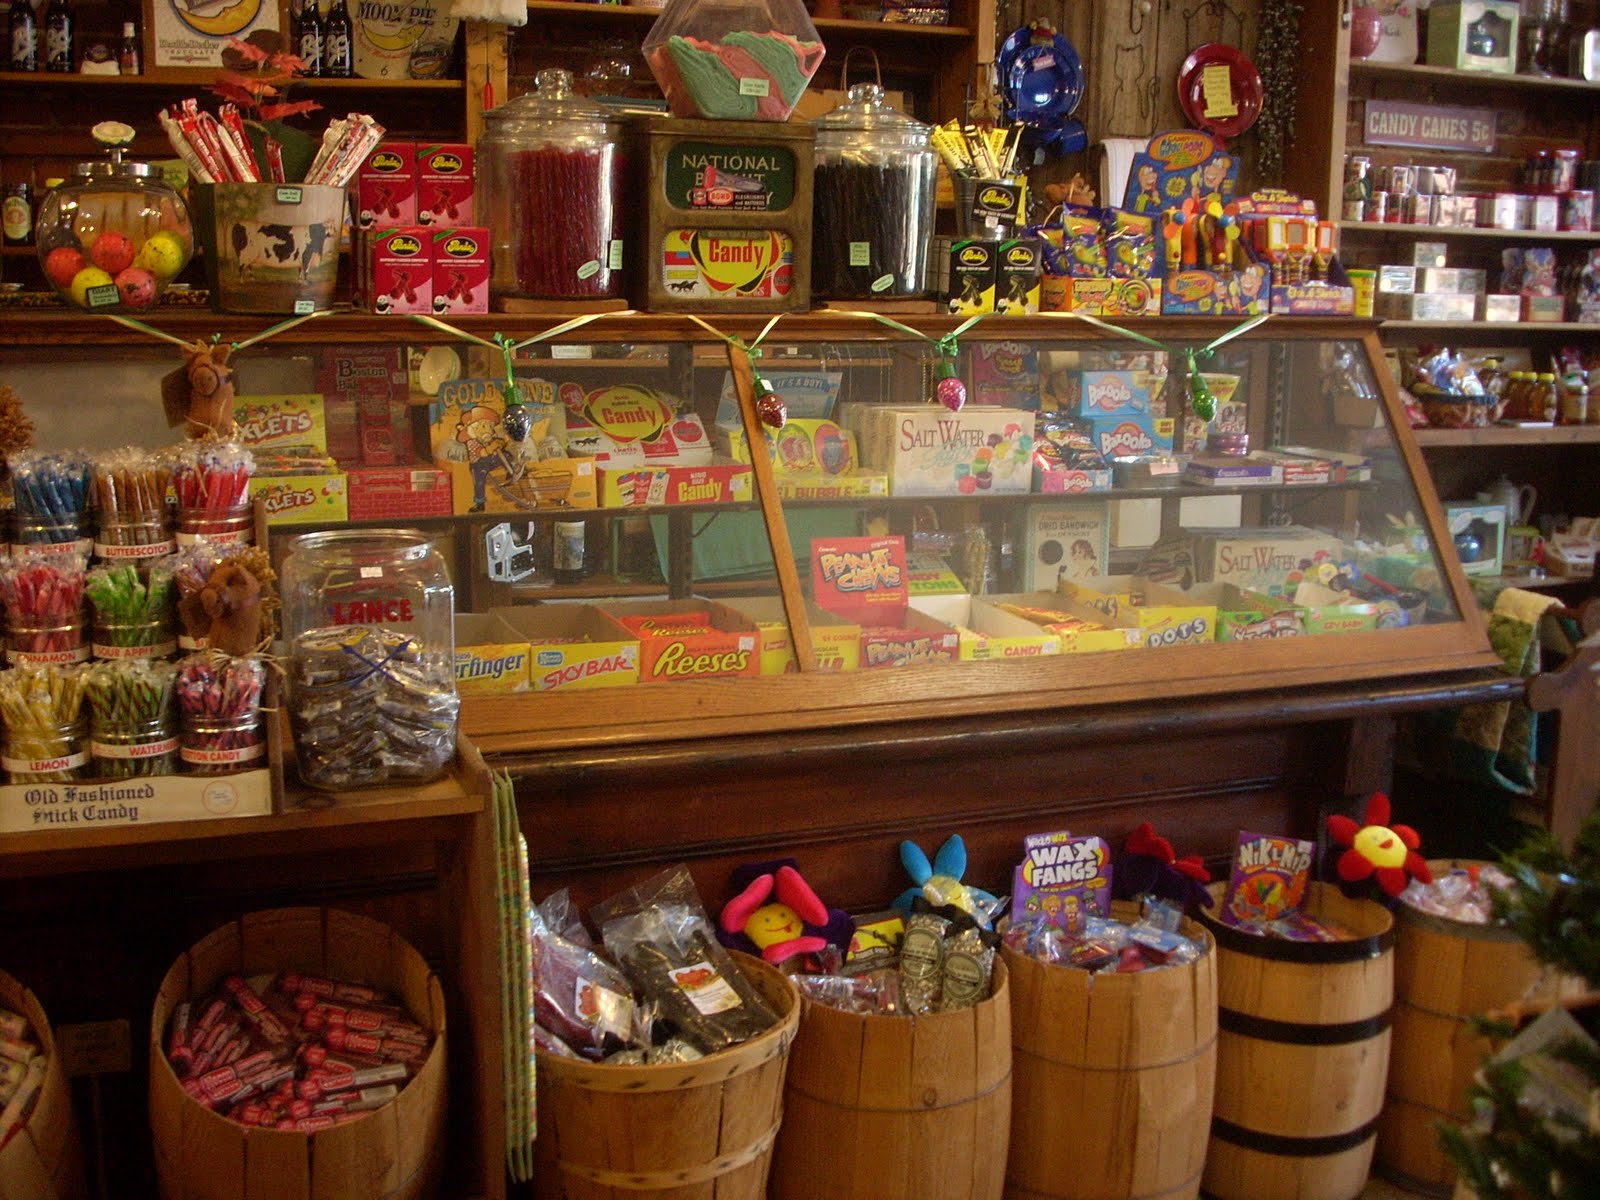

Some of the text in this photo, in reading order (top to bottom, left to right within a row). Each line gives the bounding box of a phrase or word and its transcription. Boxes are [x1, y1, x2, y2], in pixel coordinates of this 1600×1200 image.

[381, 66, 388, 76] 6
[1369, 112, 1418, 136] CANDY
[1420, 116, 1468, 141] CANES
[681, 154, 781, 171] NATIONAL
[711, 192, 731, 200] BOND
[709, 239, 764, 270] Candy
[336, 358, 387, 378] Boston
[444, 381, 496, 407] GOLD
[796, 379, 803, 387] A
[601, 407, 656, 427] Candy
[900, 419, 985, 452] SALT WATER
[1100, 431, 1152, 456] Bazooka
[678, 480, 722, 502] Candy
[1060, 521, 1099, 530] SANDWICH
[105, 545, 168, 556] BUTTERSCOTCH
[1220, 545, 1253, 574] SALT
[818, 548, 890, 582] PEANUT
[836, 564, 902, 591] CHEWS
[335, 598, 414, 625] LANCE
[1147, 617, 1206, 649] DOTS
[652, 641, 751, 677] Reese's
[1003, 645, 1044, 657] CANDY
[455, 653, 526, 680] erfinger
[30, 759, 69, 771] LEMON
[210, 751, 241, 761] CANDY
[25, 784, 155, 806] Old Fashioned
[83, 805, 139, 822] Candy
[1031, 842, 1097, 867] WAX
[1032, 860, 1098, 888] FANGS
